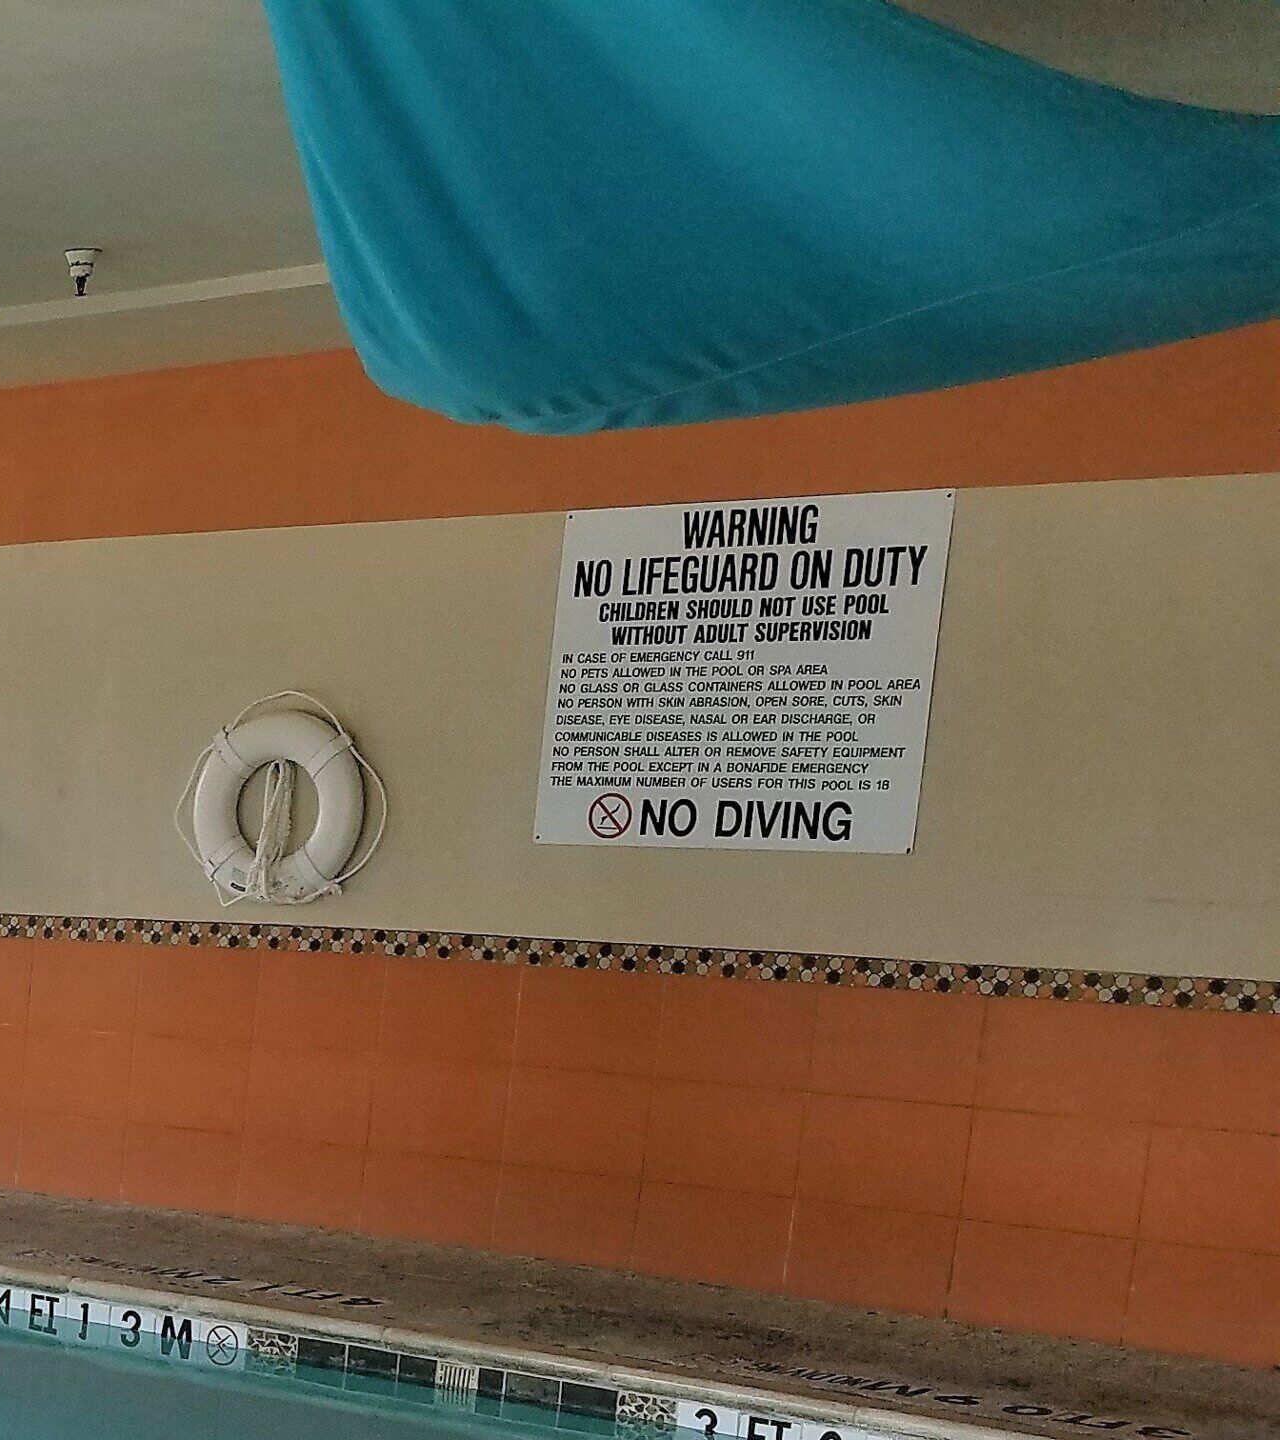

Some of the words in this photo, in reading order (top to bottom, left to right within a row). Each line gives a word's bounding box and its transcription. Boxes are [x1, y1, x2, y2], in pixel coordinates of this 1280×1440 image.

[684, 504, 818, 549] WARNING
[574, 560, 612, 597] NO
[622, 552, 778, 596] LIFEGUARD
[790, 550, 832, 589] ON
[843, 545, 928, 588] DUTY
[599, 601, 679, 622] CHILDREN
[686, 599, 752, 619] SHOULD
[759, 597, 796, 617] NOT
[802, 595, 836, 616] USE
[844, 594, 889, 614] POOL
[612, 625, 688, 645] WITHOUT
[693, 623, 749, 643] ADULT
[754, 620, 872, 642] SUPERVISION
[562, 653, 573, 663] IN
[577, 653, 606, 663] CASE
[611, 652, 627, 662] OF
[630, 651, 700, 662] EMERGENCY
[704, 651, 732, 661] CALL
[737, 650, 755, 660] 911
[561, 669, 576, 678] NO
[581, 668, 608, 678] PETS
[612, 668, 665, 678] ALLOWED
[670, 667, 681, 677] IN
[686, 667, 707, 676] THE
[711, 666, 743, 676] POOL
[748, 666, 764, 675] OR
[769, 665, 791, 675] SPA
[796, 664, 828, 674] AREA
[559, 683, 575, 693] NO
[580, 683, 618, 693] GLASS
[623, 683, 639, 692] OR
[644, 682, 683, 692] GLASS
[688, 681, 762, 692] CONTAINERS
[768, 681, 826, 691] ALLOWED
[831, 680, 843, 690] IN
[848, 680, 882, 690] POOL
[887, 679, 920, 689] AREA
[558, 698, 573, 708] NO
[578, 698, 622, 708] PERSON
[627, 698, 653, 708] WITH
[658, 697, 685, 707] SKIN
[689, 697, 750, 708] ABRASION,
[755, 696, 787, 706] OPEN
[792, 696, 828, 708] SORE,
[833, 696, 868, 707] CUTS,
[873, 695, 902, 706] SKIN
[556, 715, 605, 726] DISEASE,
[609, 715, 630, 724] EYE
[635, 714, 685, 726] DISEASE,
[690, 714, 726, 724] NASAL
[732, 714, 748, 724] OR
[753, 714, 776, 724] EAR
[781, 714, 852, 725] DISCHARGE,
[858, 713, 875, 724] OR
[555, 731, 641, 741] COMMUNICABLE
[646, 731, 702, 741] DISEASES
[706, 732, 717, 741] IS
[722, 731, 777, 742] ALLOWED
[782, 732, 793, 741] IN
[799, 731, 821, 741] THE
[826, 732, 858, 741] POOL
[552, 747, 569, 756] NO
[574, 747, 619, 756] PERSON
[624, 747, 659, 756] SHALL
[664, 747, 699, 756] ALTER
[704, 747, 721, 757] OR
[726, 747, 777, 757] REMOVE
[781, 747, 828, 757] SAFETY
[833, 748, 906, 758] EQUIPMENT
[551, 762, 583, 771] FROM
[588, 762, 609, 771] THE
[613, 762, 644, 772] POOL
[648, 762, 693, 772] EXCEPT
[698, 762, 709, 772] IN
[713, 763, 721, 772] A
[726, 762, 787, 773] BONAFIDE
[791, 763, 869, 773] EMERGENCY
[550, 777, 571, 786] THE
[576, 777, 631, 787] MAXIMUM
[636, 777, 685, 787] NUMBER
[691, 778, 707, 788] OF
[712, 778, 752, 788] USERS
[758, 778, 783, 788] FOR
[788, 779, 815, 788] THIS
[821, 780, 853, 790] POOL
[859, 780, 871, 790] IS
[639, 799, 697, 837] NO
[714, 800, 852, 841] DIVING
